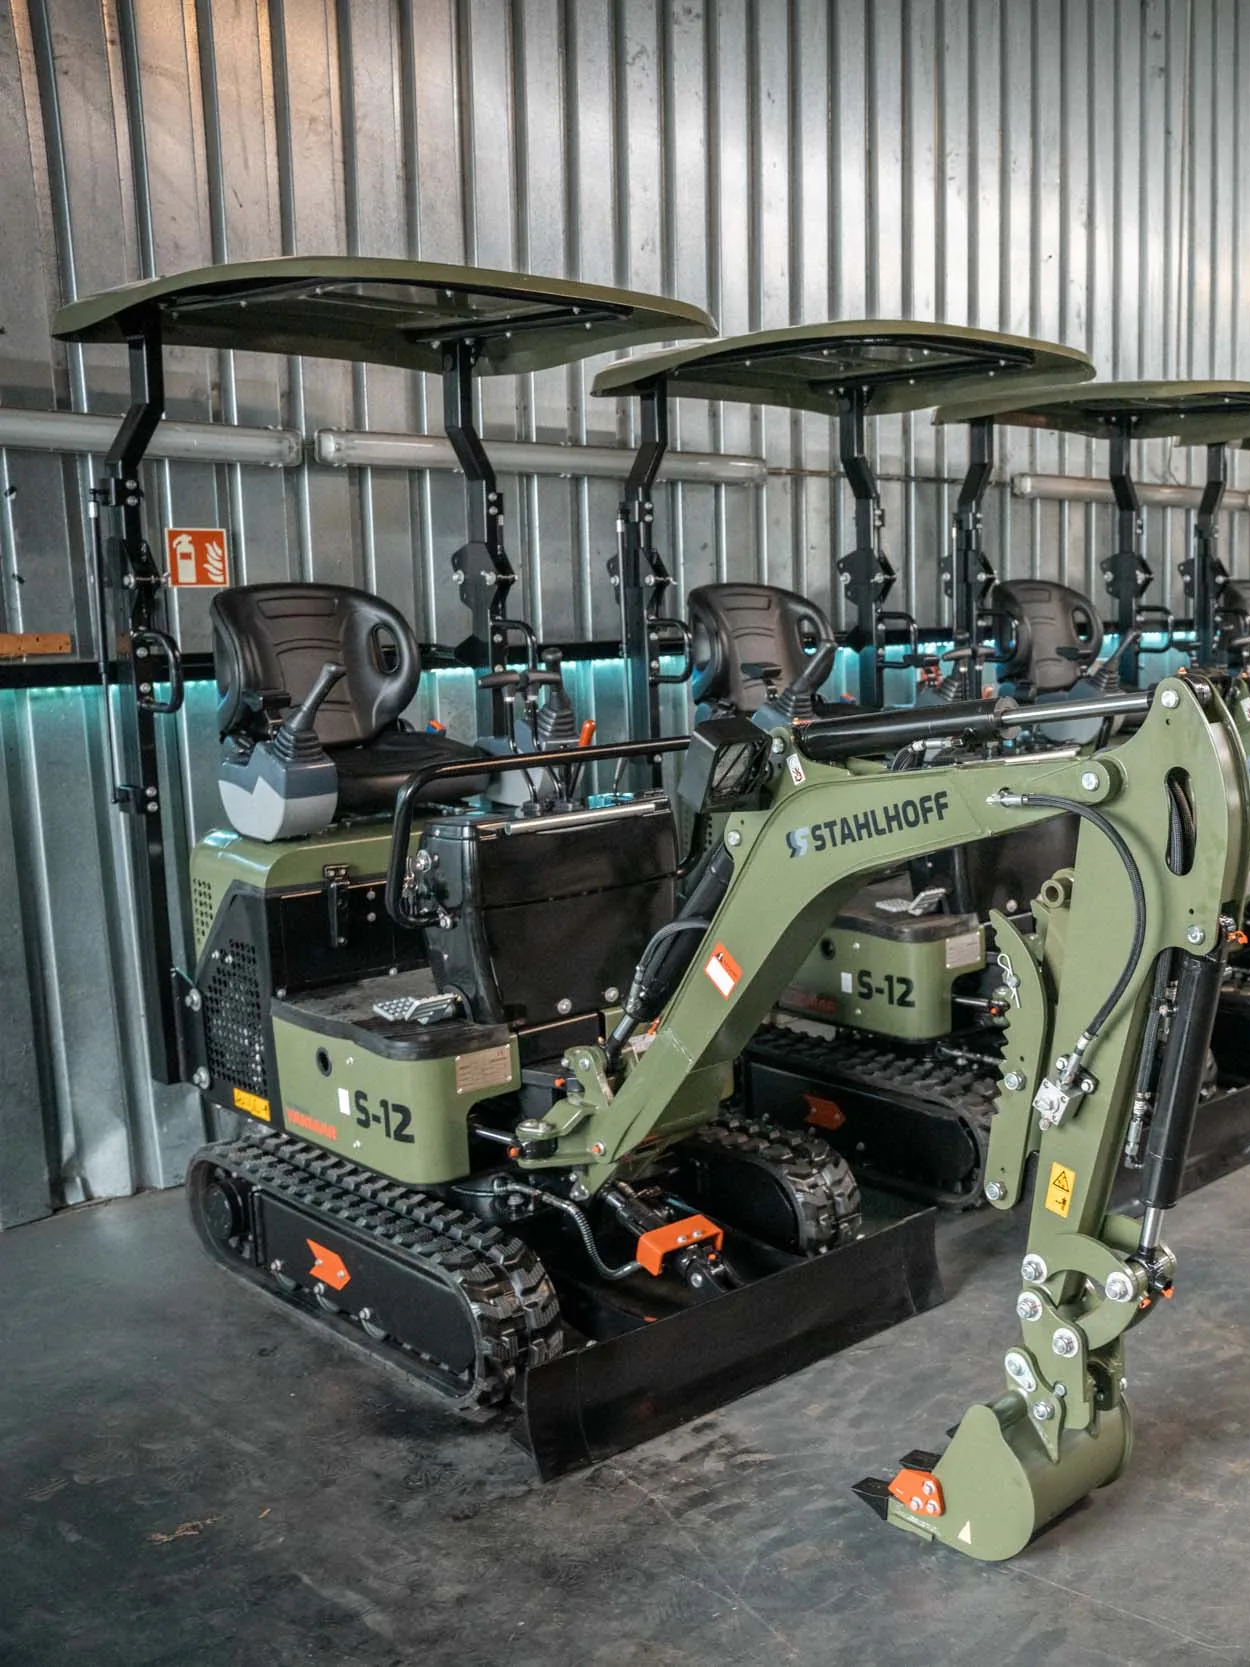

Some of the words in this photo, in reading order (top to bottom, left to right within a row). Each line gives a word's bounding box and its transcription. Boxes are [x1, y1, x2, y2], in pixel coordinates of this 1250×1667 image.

[811, 790, 948, 851] STAHLHOFF
[856, 969, 915, 1008] S-12
[355, 1090, 415, 1144] S-12
